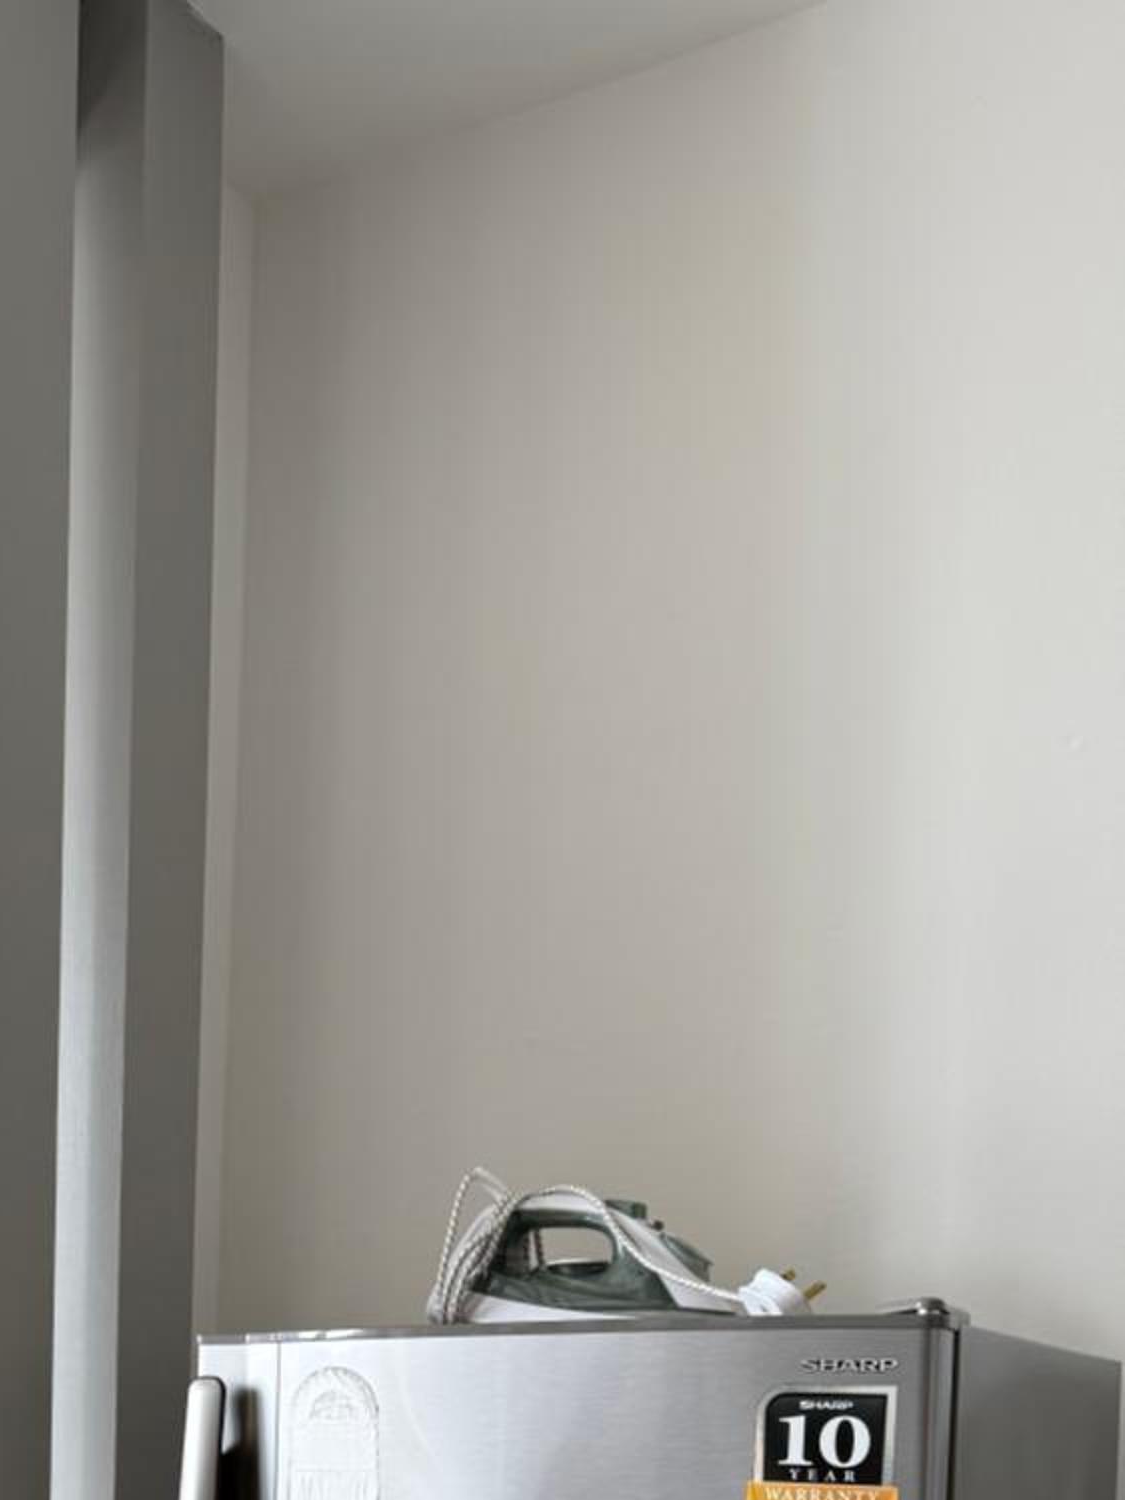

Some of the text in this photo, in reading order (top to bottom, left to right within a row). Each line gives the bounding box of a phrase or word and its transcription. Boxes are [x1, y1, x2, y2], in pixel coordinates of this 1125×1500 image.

[800, 1358, 899, 1373] SHARP
[798, 1400, 853, 1411] SHARP
[778, 1415, 871, 1468] 10
[789, 1469, 856, 1483] YEAR
